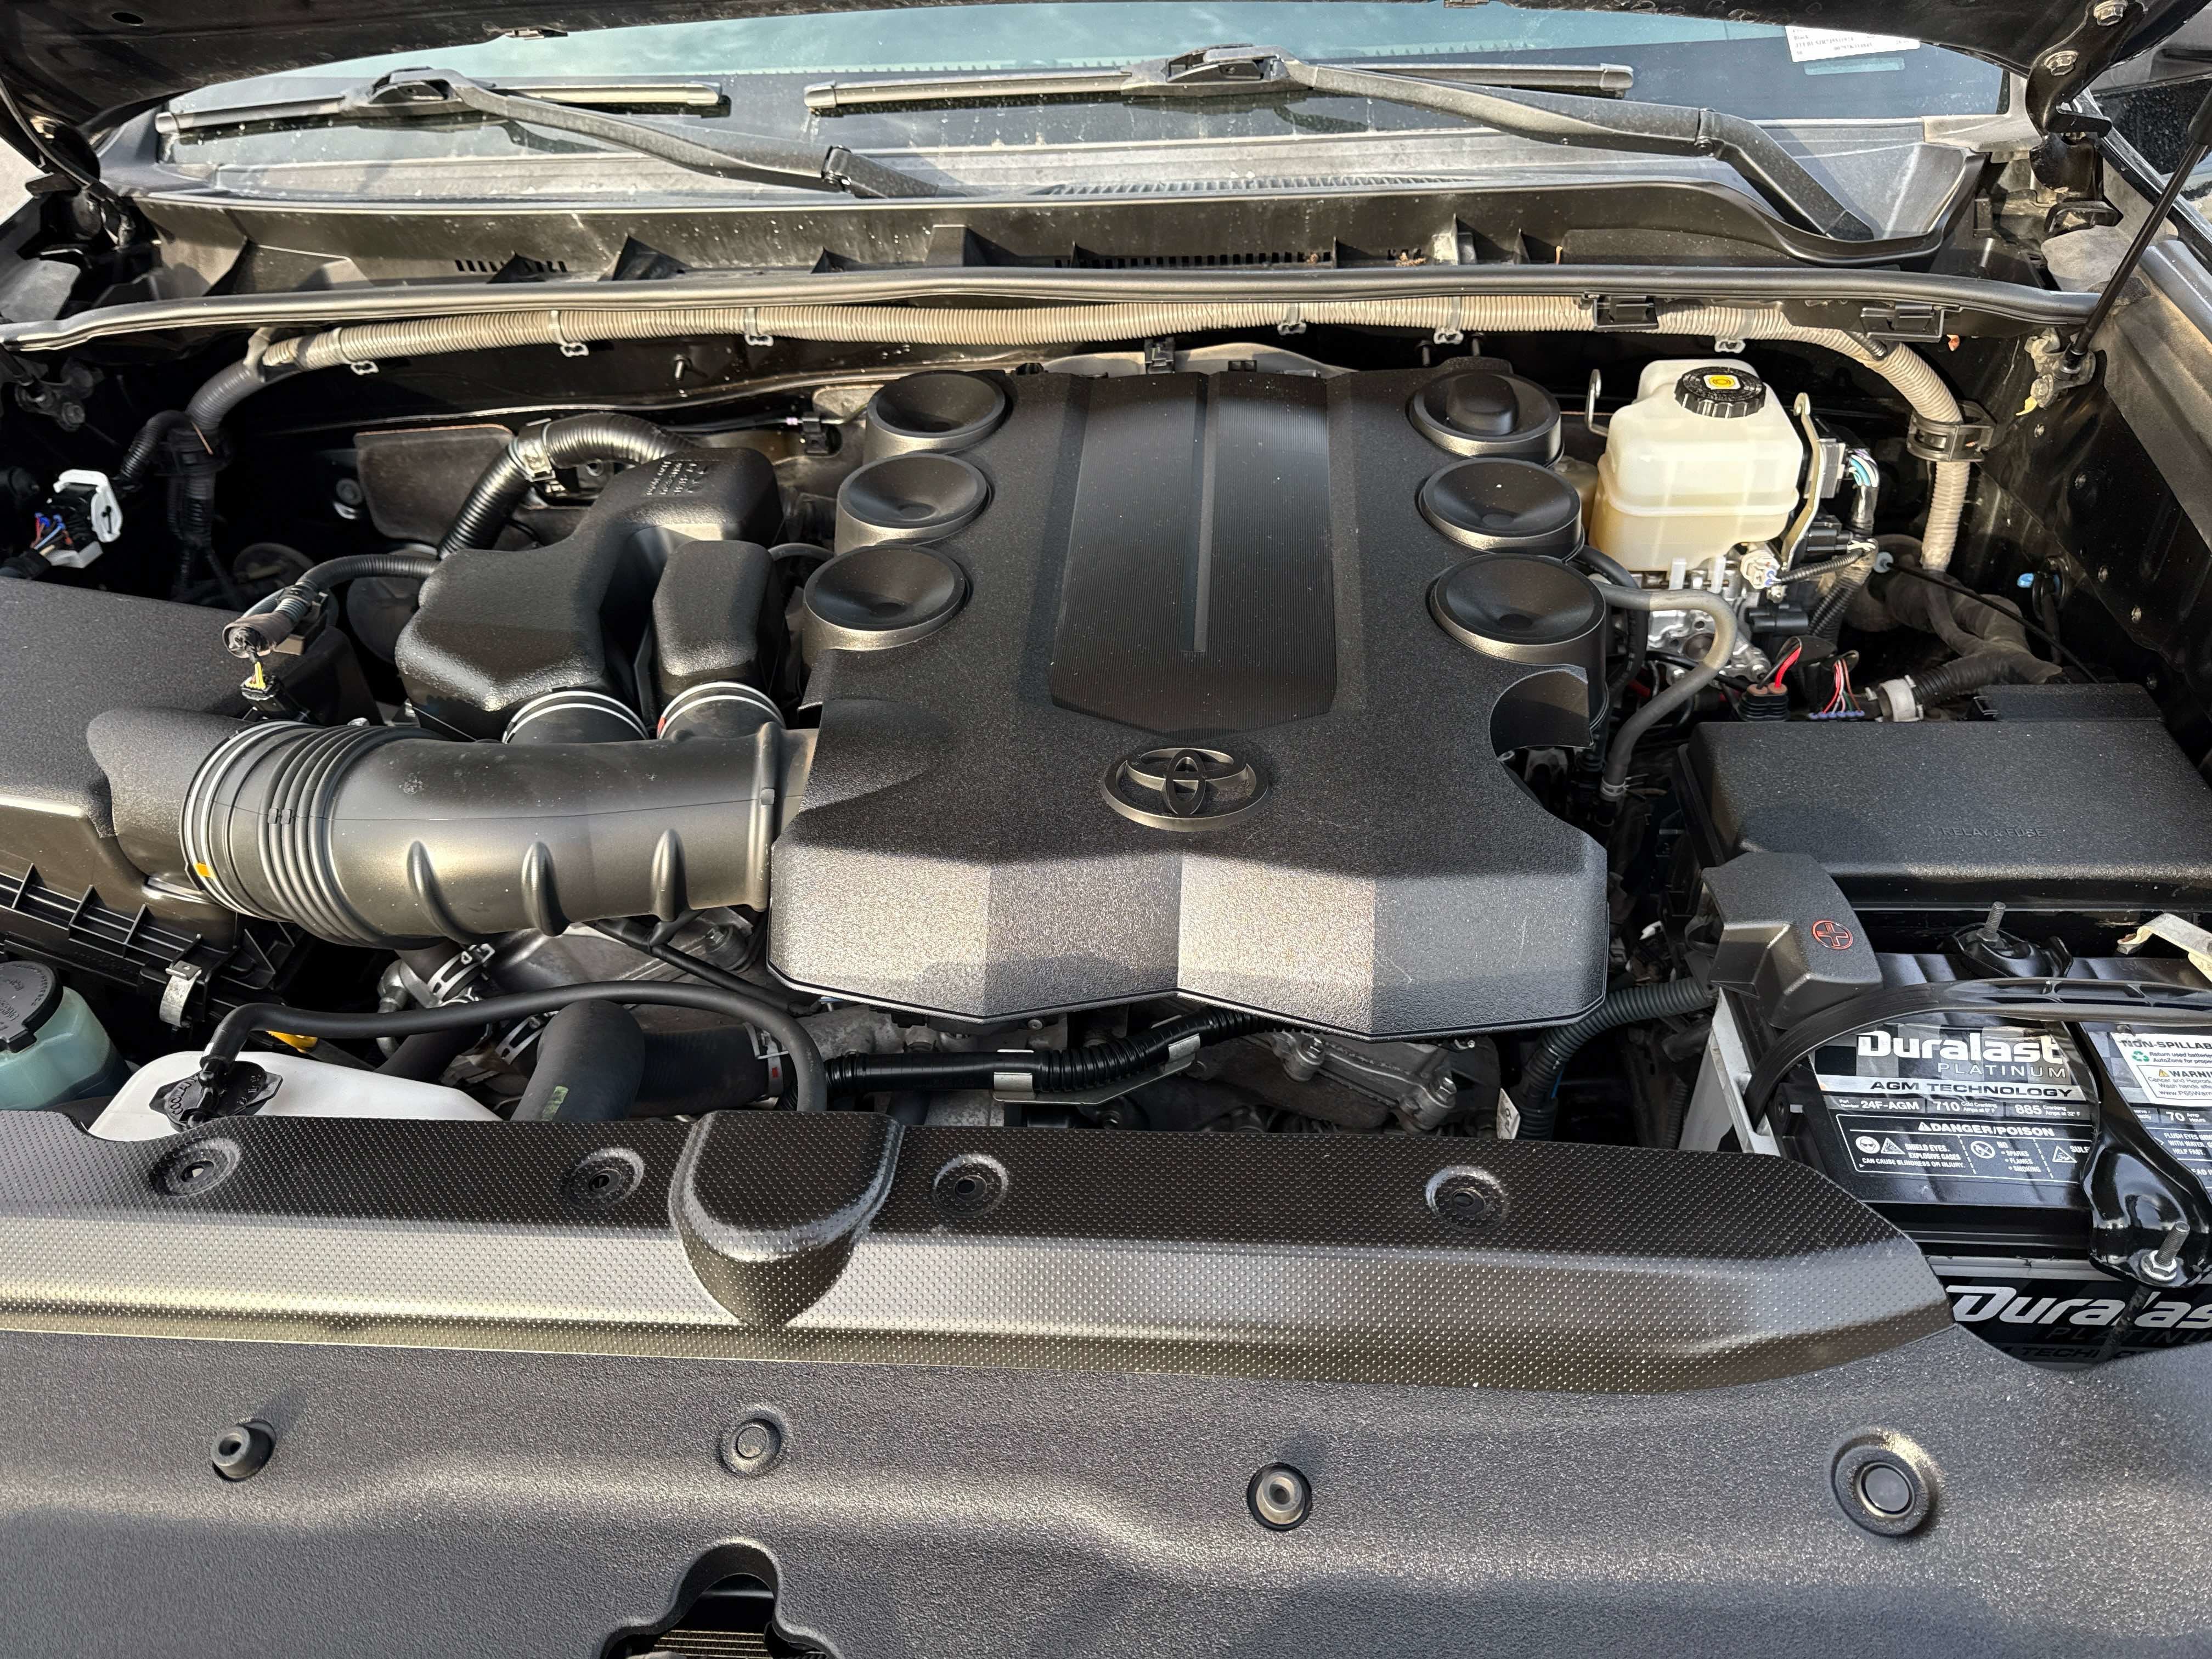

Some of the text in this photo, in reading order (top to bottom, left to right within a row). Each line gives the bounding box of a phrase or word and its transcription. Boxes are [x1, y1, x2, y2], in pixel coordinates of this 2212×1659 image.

[1940, 827, 2047, 837] RELAY & FUSE
[1855, 1030, 2063, 1064] Duralast
[1937, 1062, 2066, 1079] PLATINUM
[1870, 1081, 2073, 1097] AGM TECHNOLOGY
[1860, 1100, 1920, 1110] 24F-AGM
[1933, 1101, 1960, 1111] 710
[2015, 1104, 2042, 1115] 885
[2165, 1111, 2185, 1122] 70
[1930, 1123, 2055, 1137] DANGER/POISON
